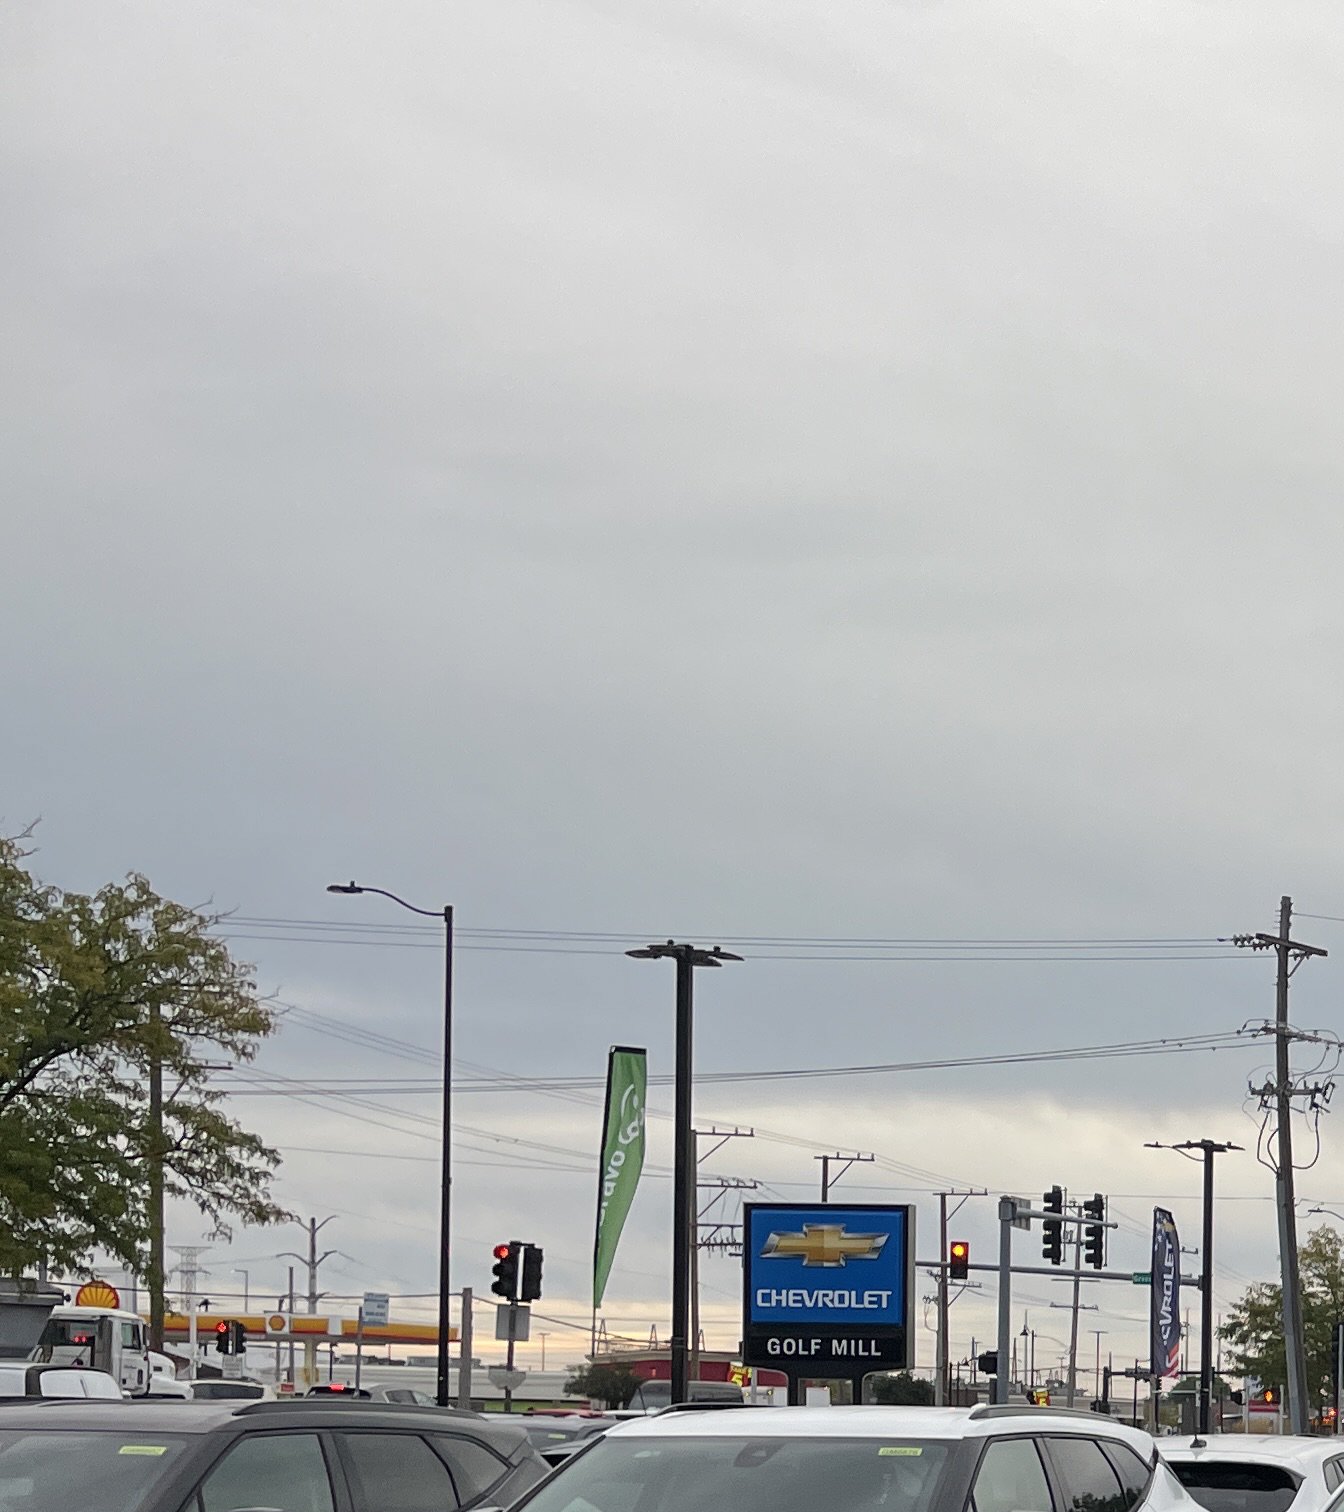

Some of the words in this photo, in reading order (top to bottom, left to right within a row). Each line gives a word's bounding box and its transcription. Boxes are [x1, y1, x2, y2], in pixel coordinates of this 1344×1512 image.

[756, 1289, 892, 1308] CHEVROLET
[767, 1338, 822, 1356] GOLF
[831, 1339, 882, 1357] MILL
